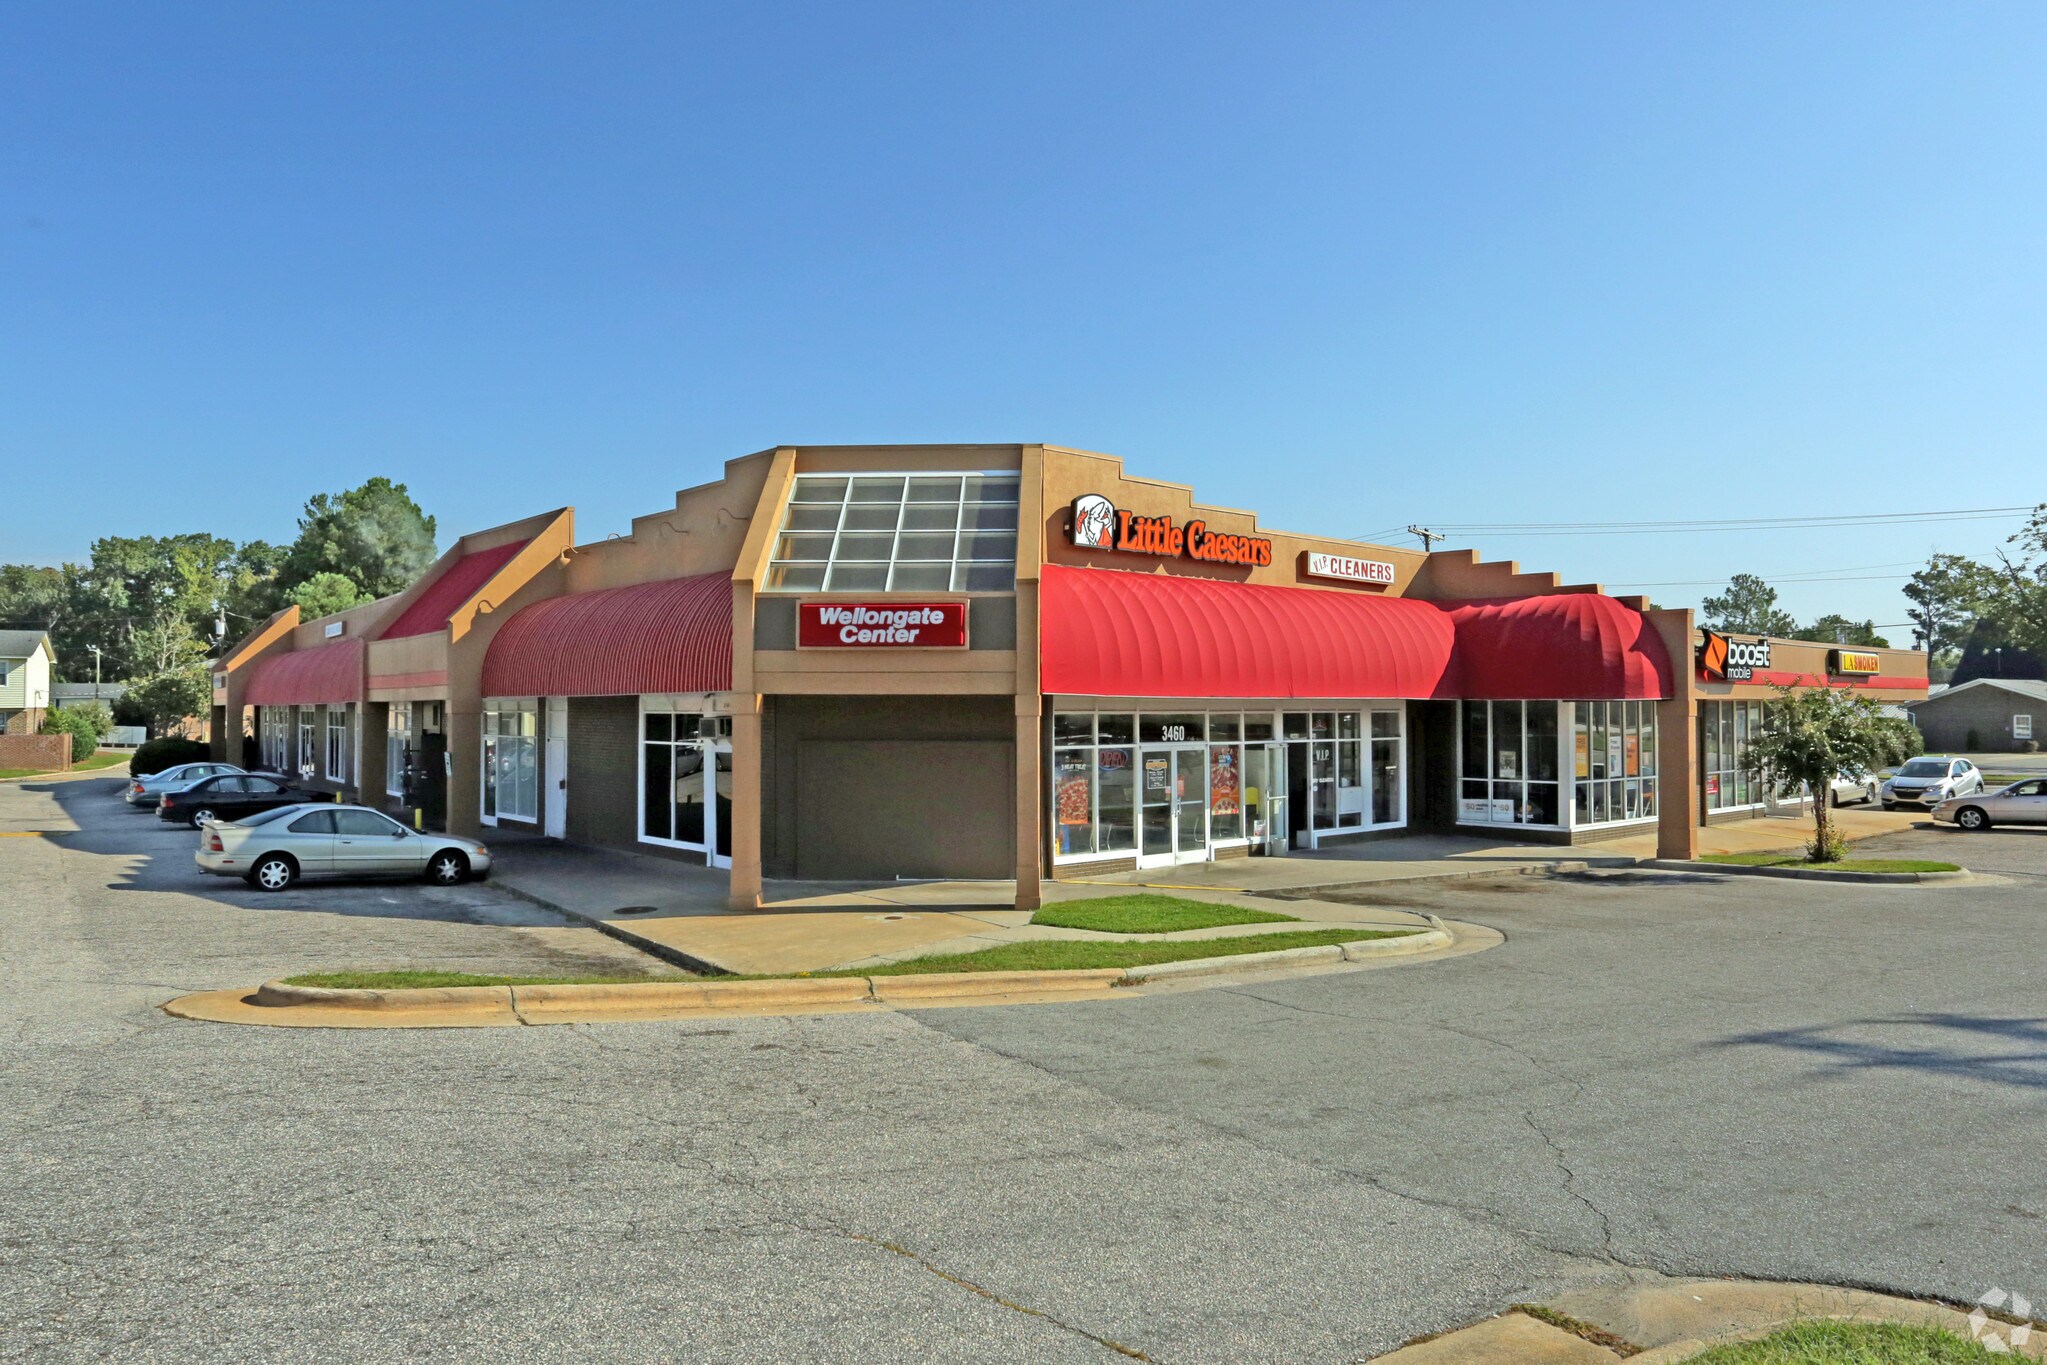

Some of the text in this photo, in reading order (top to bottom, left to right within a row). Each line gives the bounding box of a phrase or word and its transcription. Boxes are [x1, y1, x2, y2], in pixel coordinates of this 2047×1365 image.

[1117, 509, 1272, 567] Little Caesars
[1330, 557, 1392, 581] CLEANERS
[819, 607, 945, 629] Wellongate
[839, 625, 920, 644] Center
[1727, 638, 1770, 667] boost
[1727, 667, 1751, 679] mobile
[1162, 725, 1185, 741] 3460
[1099, 751, 1124, 768] OPEN
